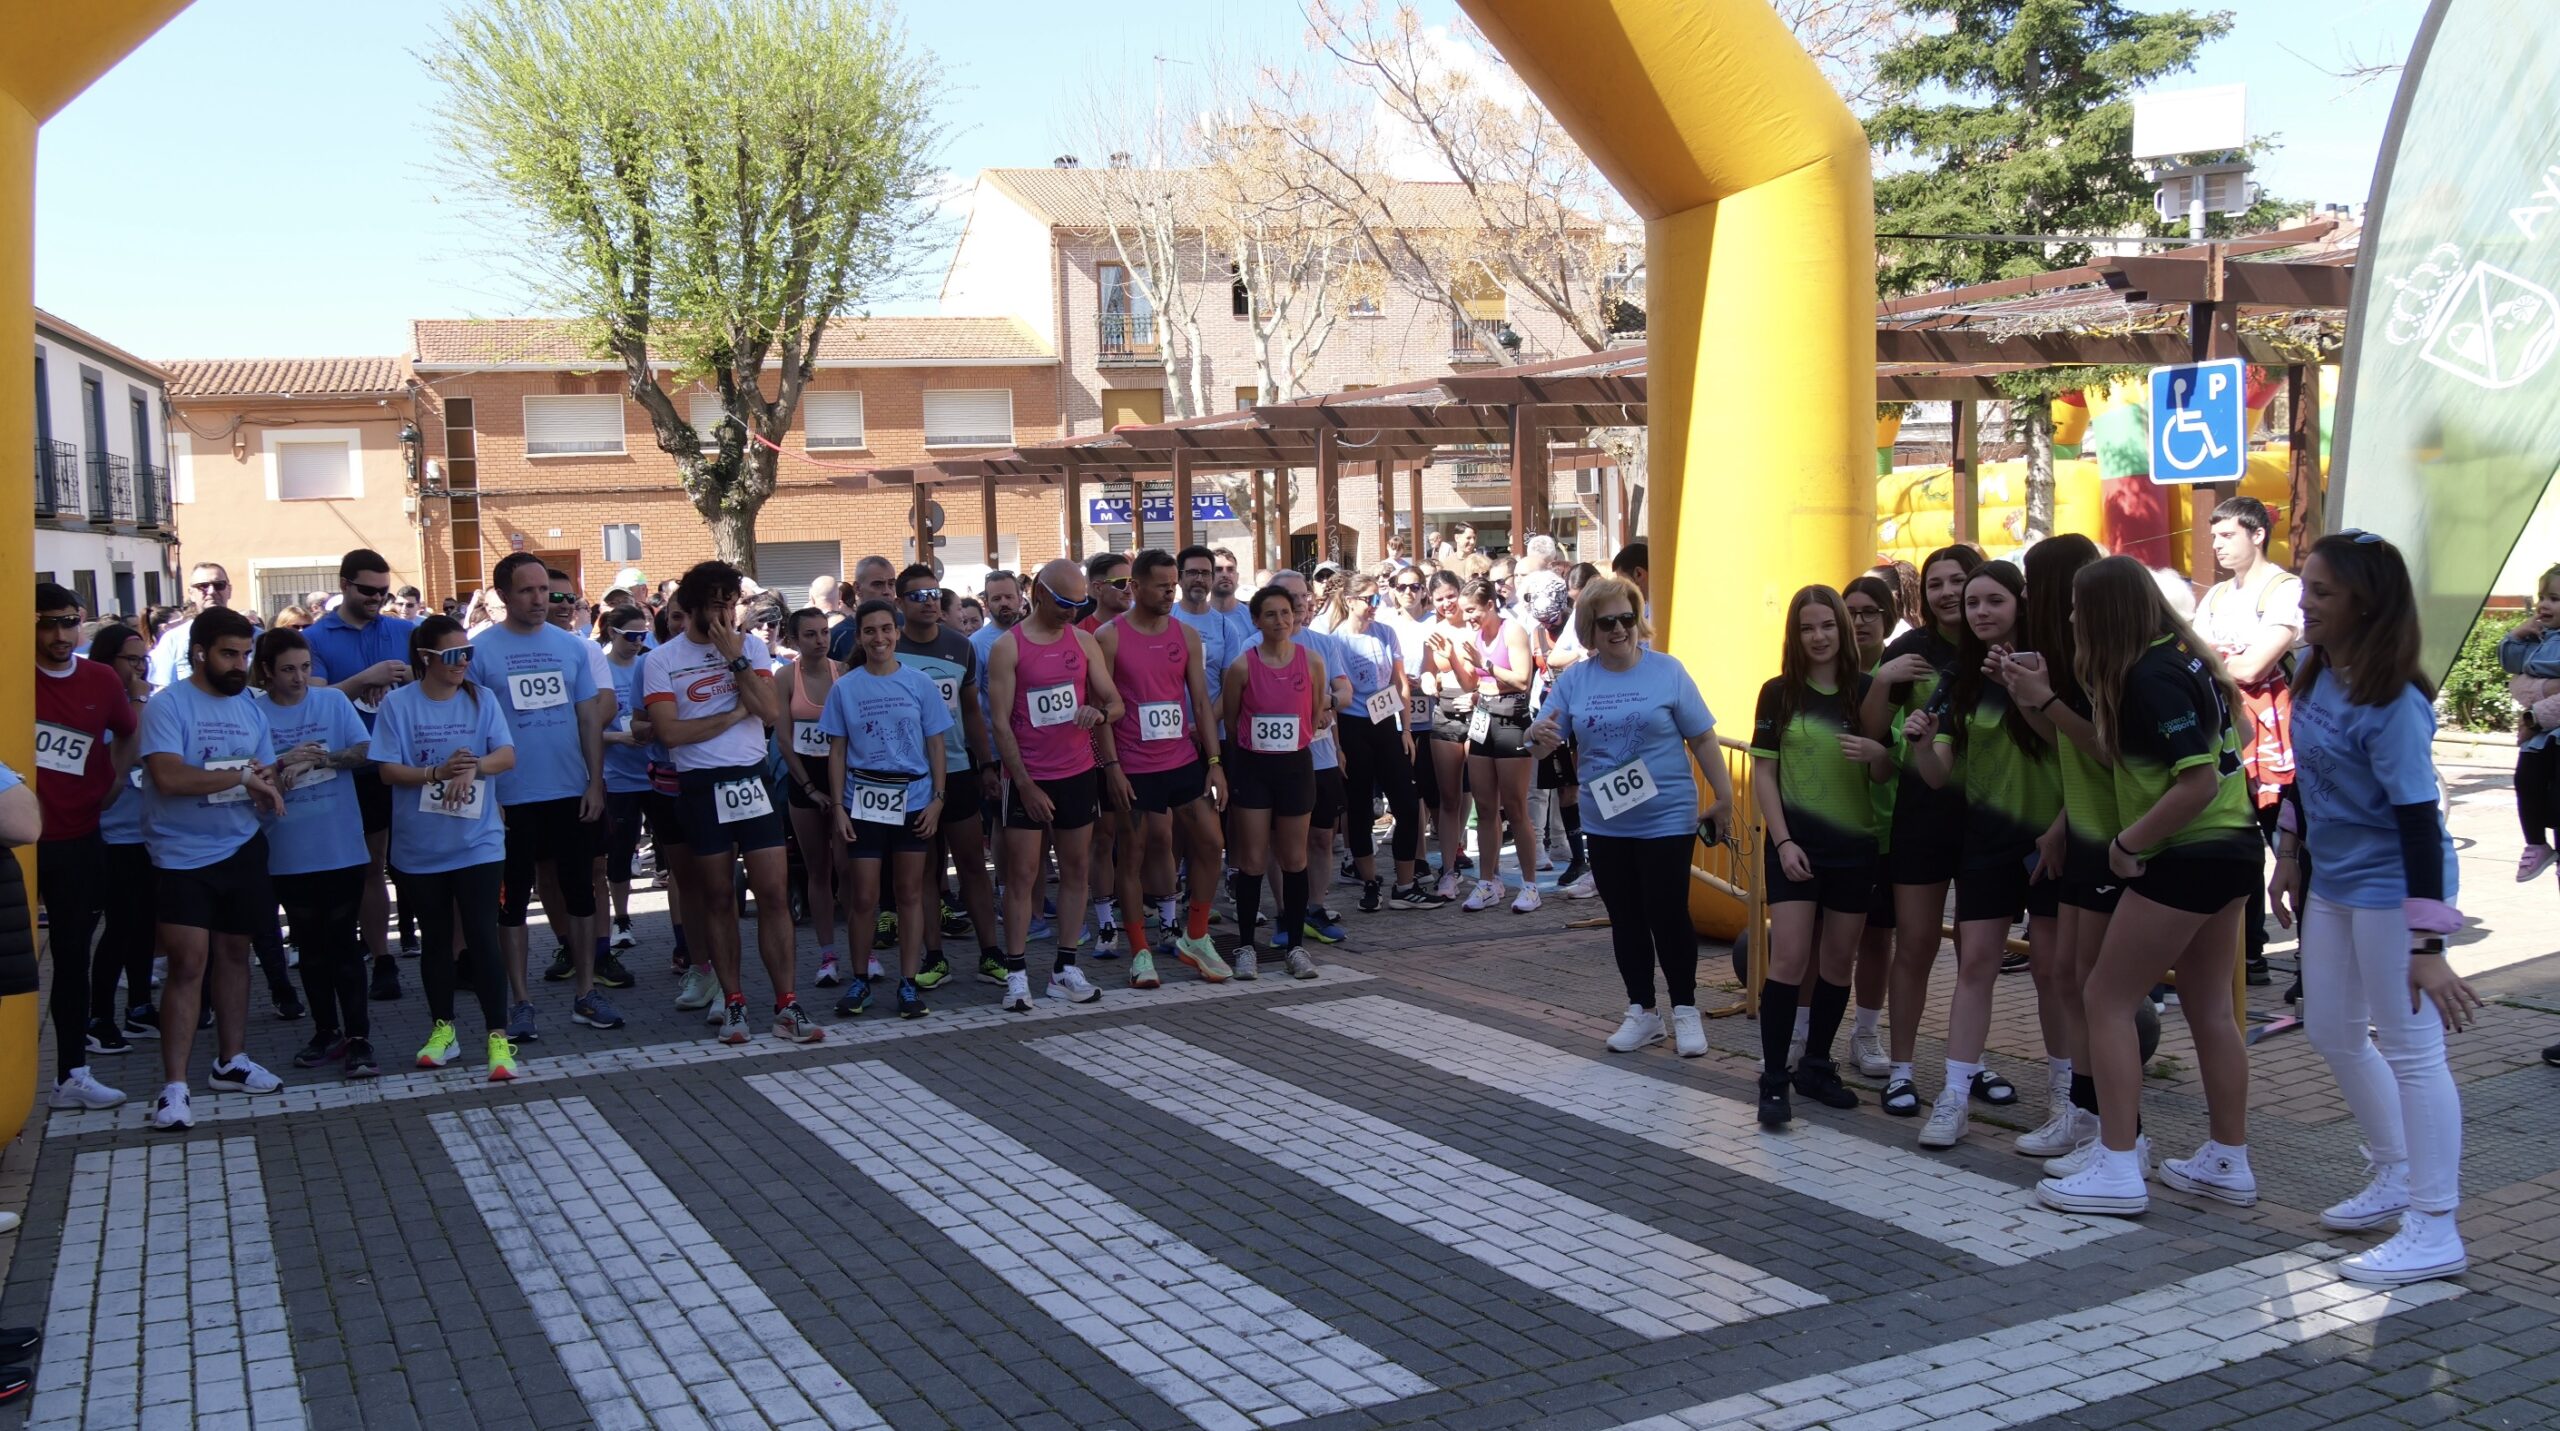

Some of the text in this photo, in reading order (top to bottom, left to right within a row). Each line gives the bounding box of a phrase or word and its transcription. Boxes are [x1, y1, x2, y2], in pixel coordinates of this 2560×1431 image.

[2209, 372, 2227, 400] P
[520, 676, 561, 698] 093
[1037, 690, 1074, 714] 039
[1370, 691, 1394, 713] 131
[1148, 708, 1181, 728] 036
[1257, 722, 1294, 740] 383
[36, 731, 86, 760] 045
[430, 781, 477, 805] 33
[725, 784, 764, 809] 094
[1599, 768, 1644, 802] 166
[863, 790, 903, 813] 092
